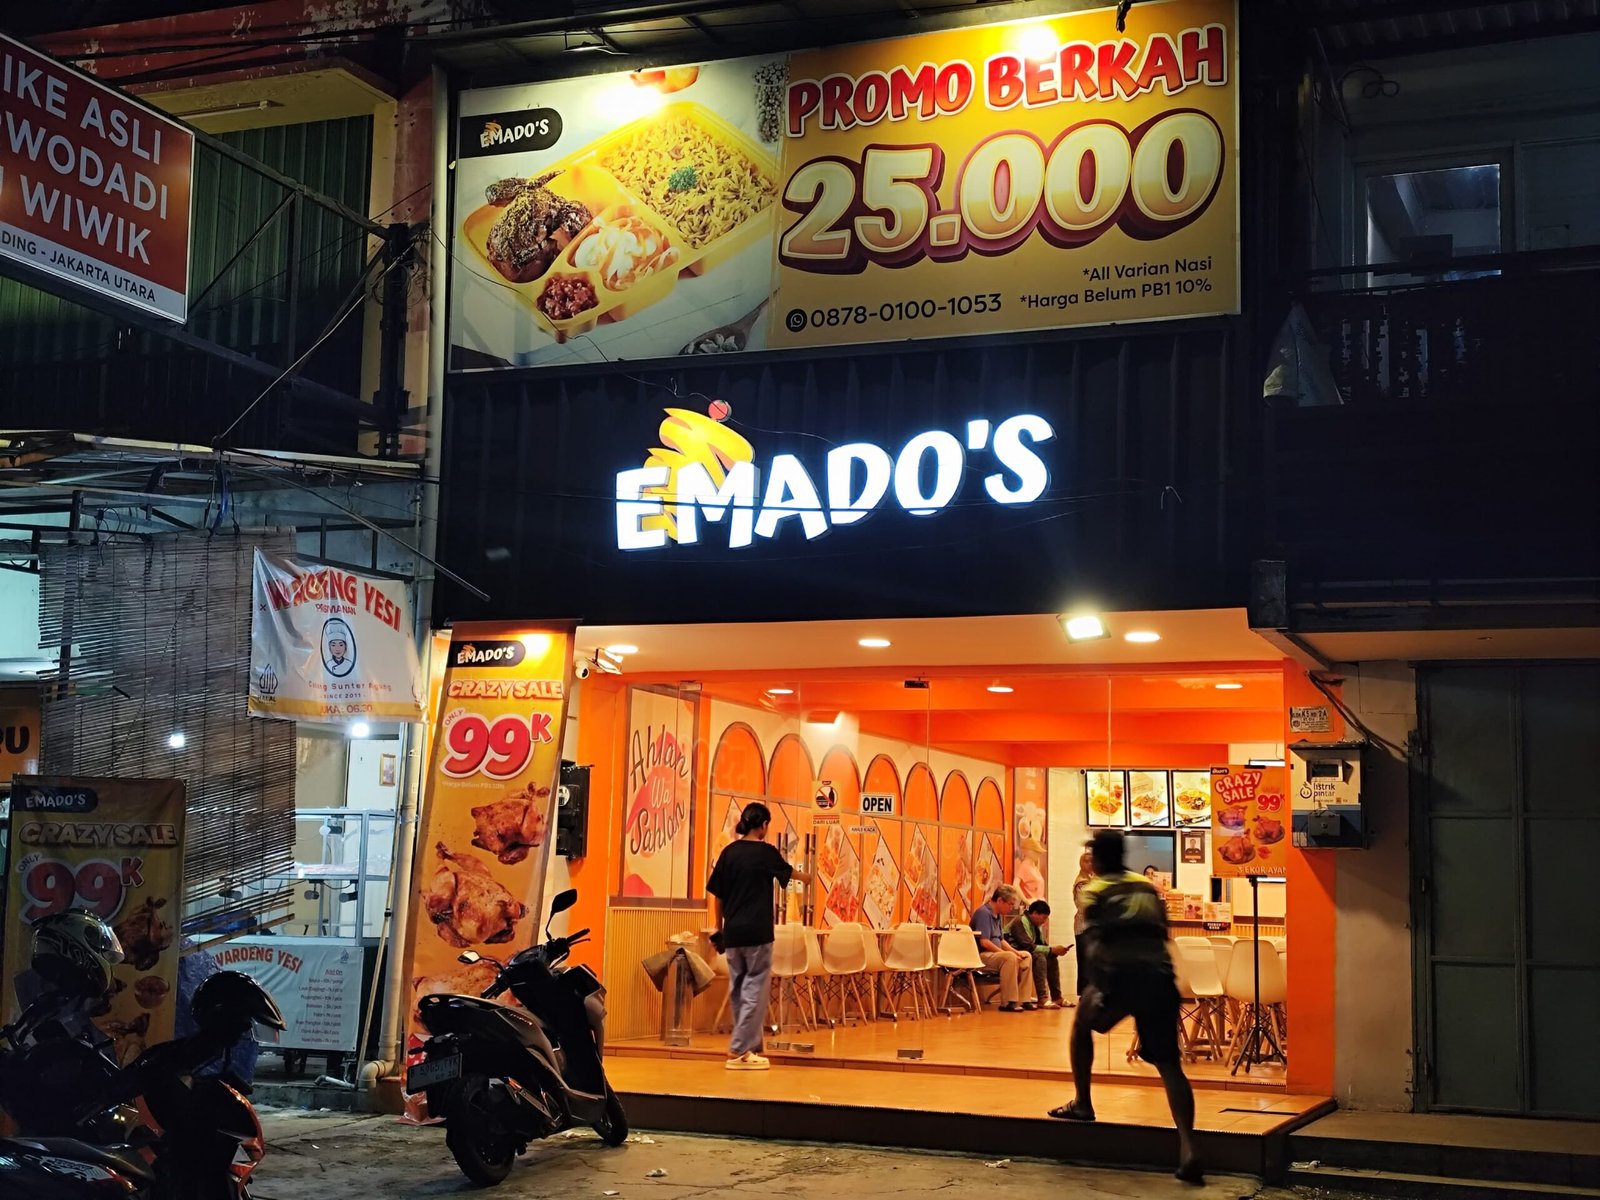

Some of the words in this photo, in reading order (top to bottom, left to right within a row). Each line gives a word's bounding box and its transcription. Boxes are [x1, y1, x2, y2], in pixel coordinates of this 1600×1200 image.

[787, 60, 974, 136] PROMO
[986, 24, 1226, 109] BERKAH
[80, 97, 161, 165] ASLI
[480, 119, 550, 148] EMADO'S
[0, 110, 167, 219] WODADI
[780, 110, 1223, 264] 25.000
[20, 174, 151, 265] WIWIK
[50, 249, 110, 287] JAKARTA
[114, 276, 156, 303] UTARA
[1114, 262, 1169, 281] Varian
[1174, 255, 1212, 273] Nasi
[1084, 285, 1136, 303] Belum
[1141, 282, 1171, 299] PB1
[1176, 277, 1212, 294] 10%
[810, 293, 1002, 329] 0878-0100-1053
[615, 414, 1056, 550] EMADO'S
[364, 581, 402, 632] YESI
[457, 646, 515, 664] EMADO'S
[331, 682, 365, 690] Sunter
[448, 680, 511, 699] CRAZY
[513, 680, 564, 700] SALE
[444, 709, 464, 726] ONLY
[630, 724, 688, 793] Ahlan
[652, 776, 670, 808] Wa
[1215, 772, 1261, 793] CRAZY
[1222, 786, 1255, 803] SALE
[26, 793, 86, 808] EMADO'S
[862, 796, 892, 812] OPEN
[19, 823, 114, 848] CRAZY
[115, 823, 178, 848] SALE
[630, 800, 685, 855] Sahlan
[17, 853, 41, 872] ONLY
[1245, 866, 1266, 874] EKOR
[278, 950, 304, 974] YESI
